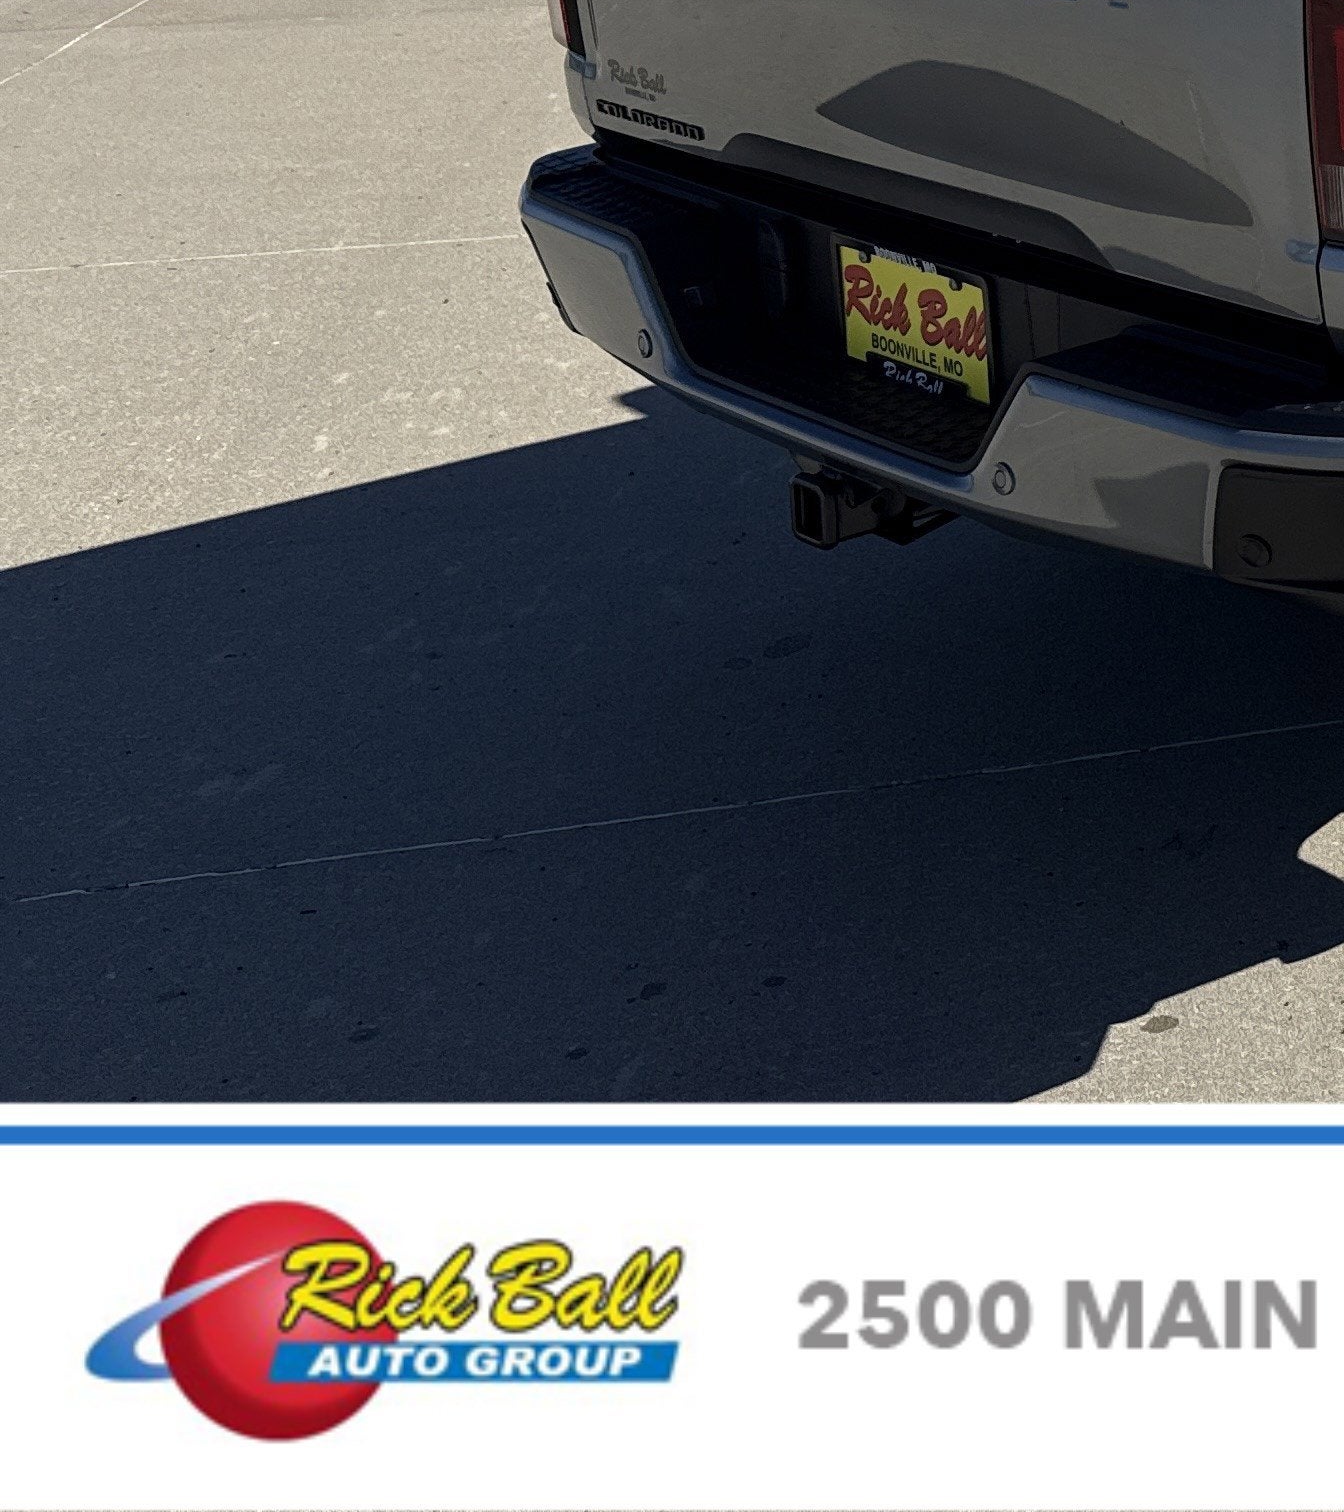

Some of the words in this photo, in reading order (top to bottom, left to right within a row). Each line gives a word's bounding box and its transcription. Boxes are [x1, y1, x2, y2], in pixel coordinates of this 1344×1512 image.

[595, 97, 706, 142] COLORADO
[844, 264, 911, 337] Rick
[917, 288, 988, 361] Ball
[870, 332, 941, 373] BOONVILLE,
[943, 355, 964, 377] MO
